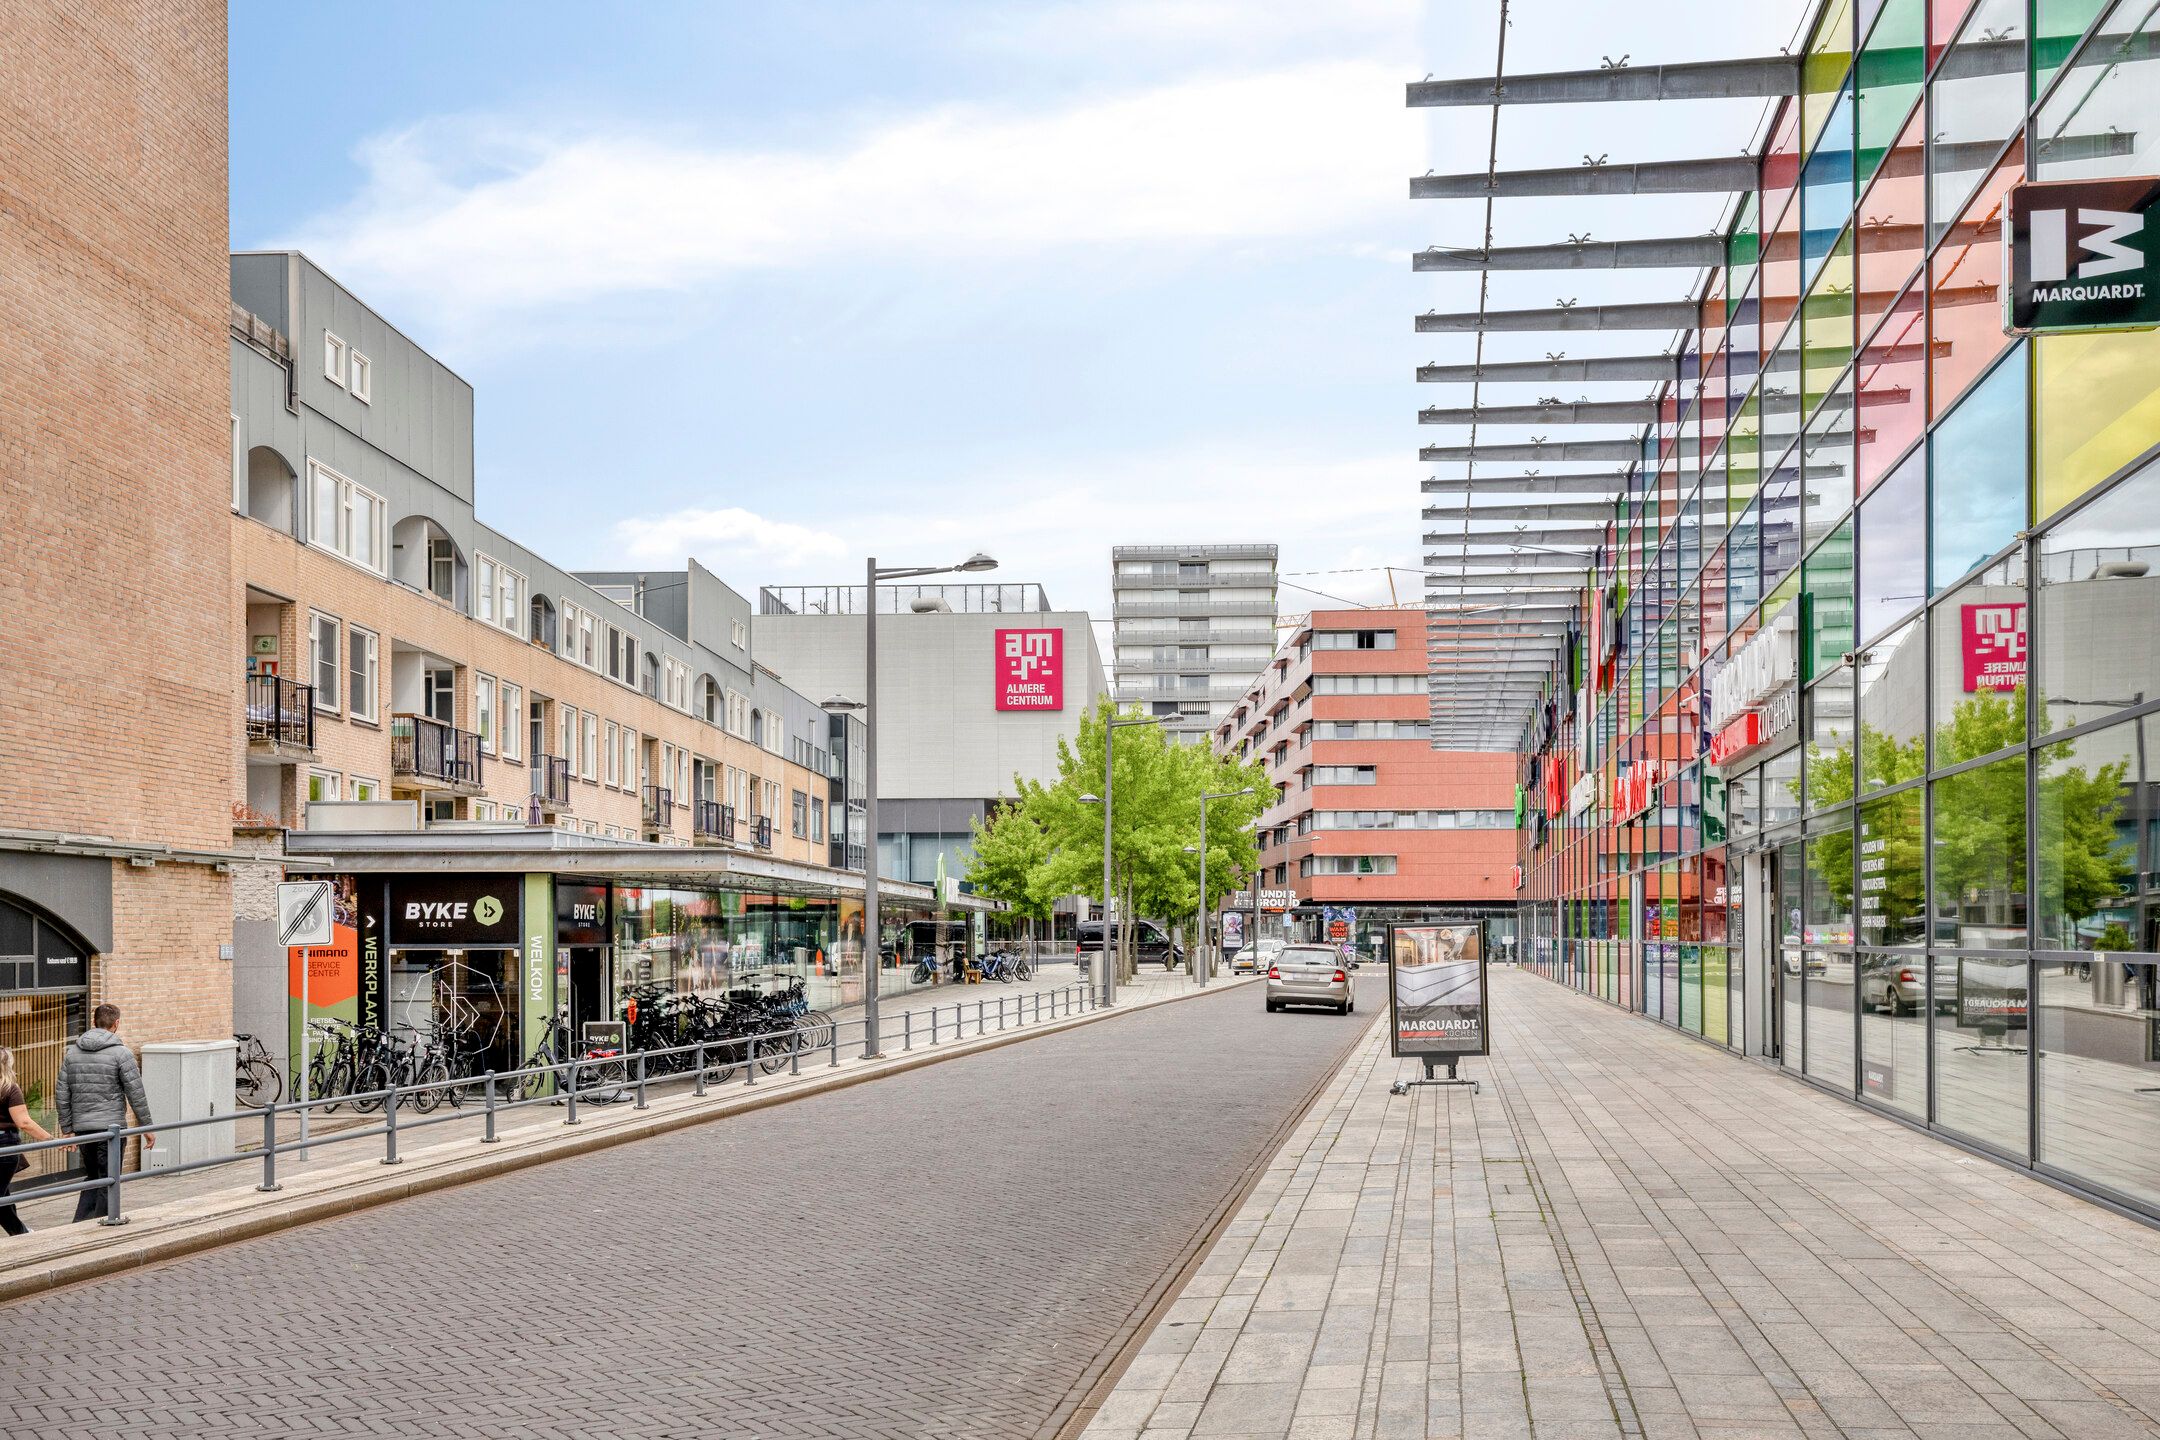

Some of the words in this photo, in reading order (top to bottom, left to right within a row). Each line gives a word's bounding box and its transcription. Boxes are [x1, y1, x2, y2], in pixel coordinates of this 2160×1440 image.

[1006, 684, 1045, 693] ALMERE
[1006, 696, 1053, 705] CENTRUM
[405, 902, 468, 920] BYKE
[573, 903, 595, 920] BYKE
[530, 935, 543, 1001] WELKOM
[365, 936, 378, 1039] WERKPLAATS
